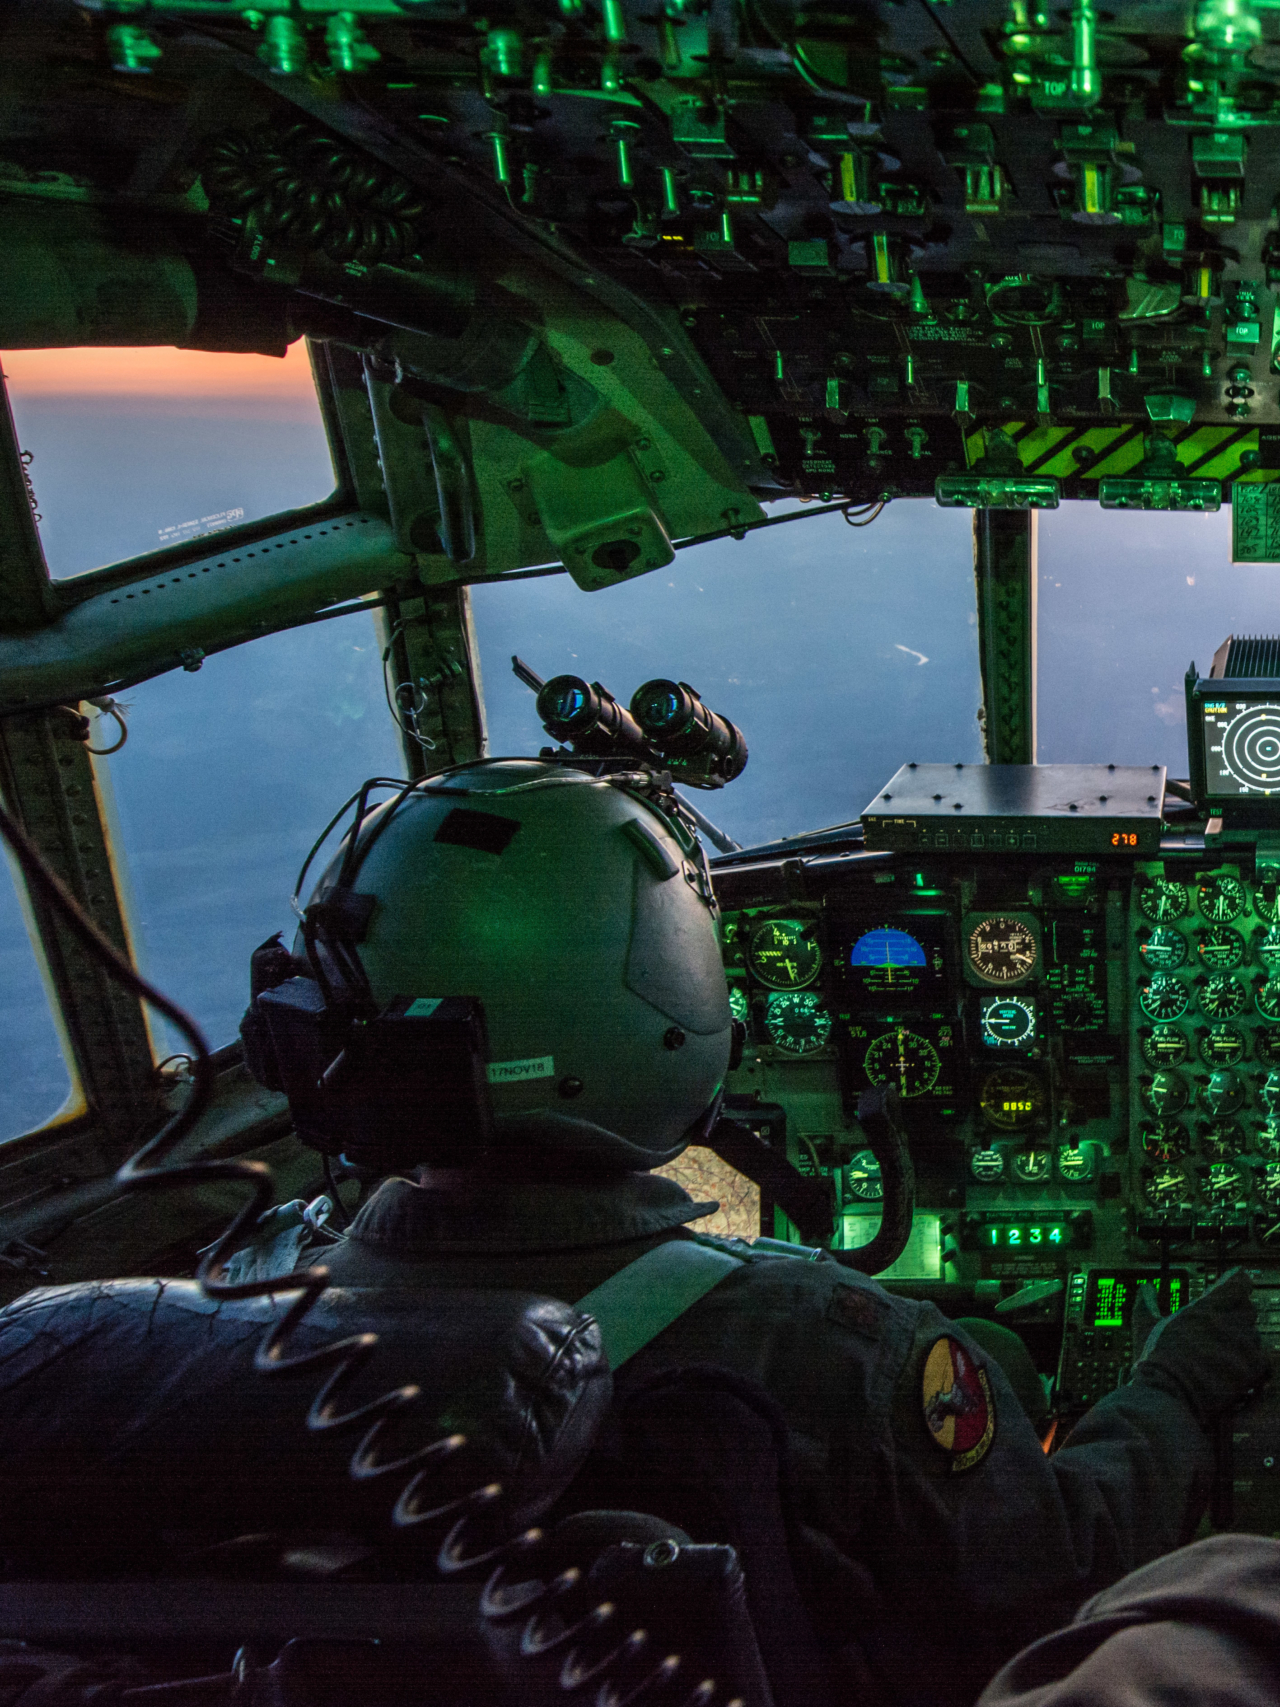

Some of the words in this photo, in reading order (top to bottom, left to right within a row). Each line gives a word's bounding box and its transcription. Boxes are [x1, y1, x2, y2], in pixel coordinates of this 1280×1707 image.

[1044, 81, 1066, 96] TOP
[1236, 326, 1249, 334] TOP
[1209, 808, 1223, 816] TEST
[1111, 832, 1137, 846] 278
[991, 1229, 997, 1245] 1
[1008, 1229, 1021, 1244] 2
[1029, 1228, 1042, 1243] 3
[1049, 1228, 1062, 1244] 4
